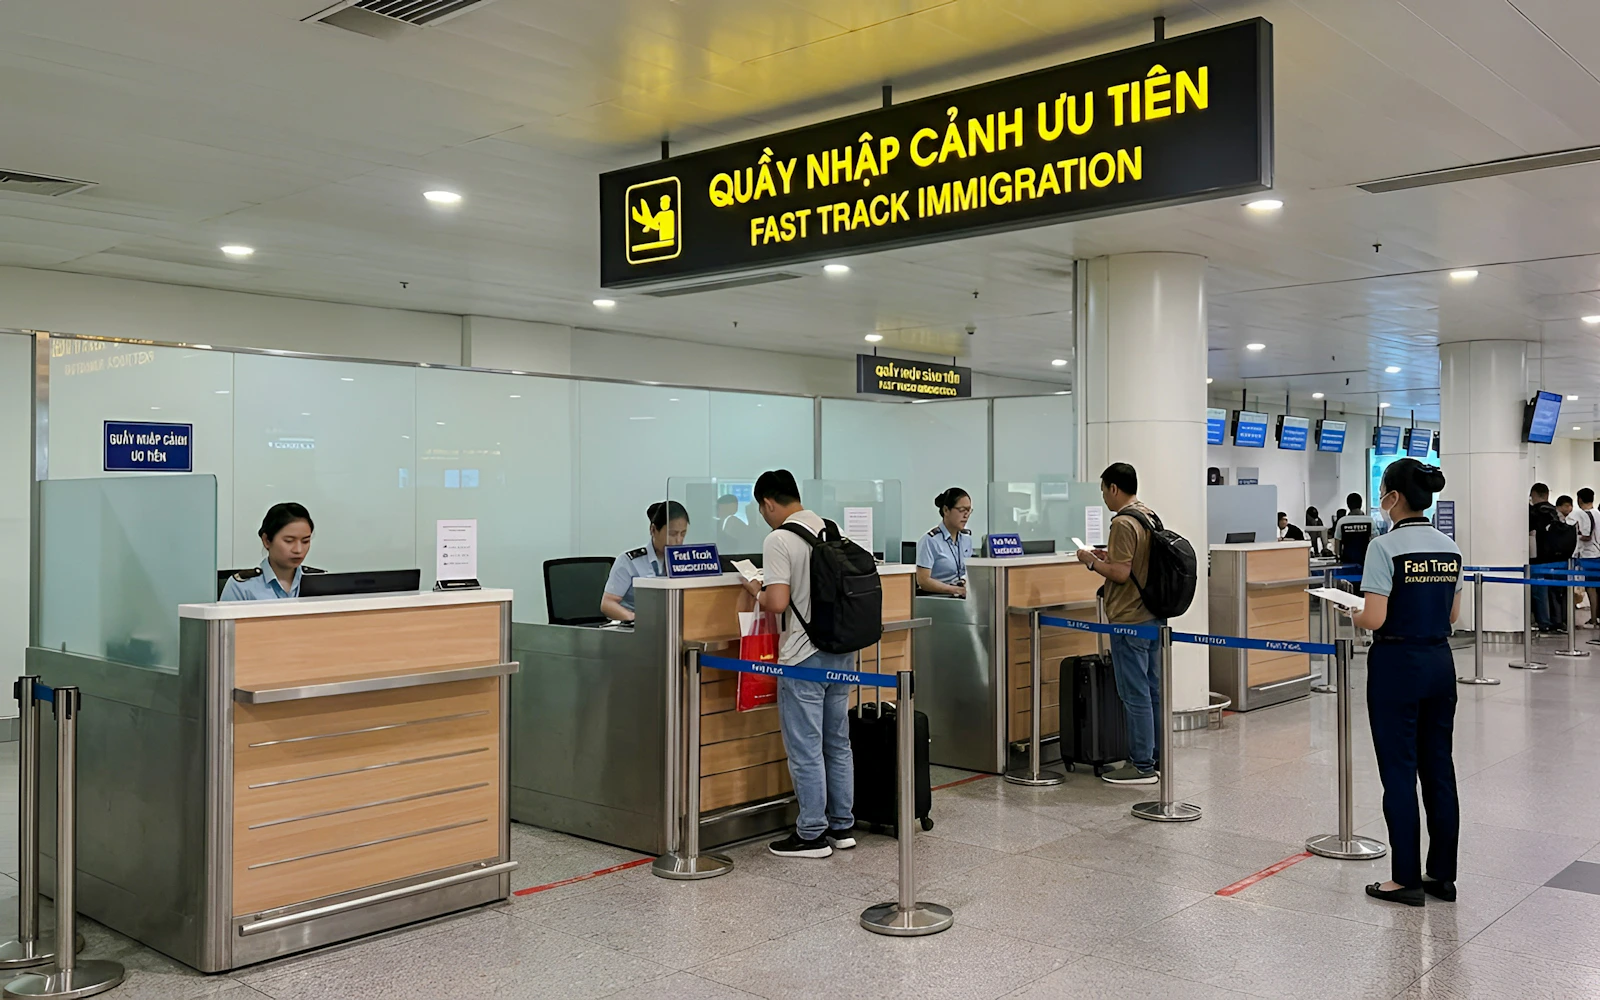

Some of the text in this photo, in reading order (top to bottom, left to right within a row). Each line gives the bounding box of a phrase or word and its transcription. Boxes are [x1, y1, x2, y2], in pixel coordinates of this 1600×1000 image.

[709, 64, 1209, 208] QUẦY NHẬP CẢNH ƯU TIÊN
[750, 145, 1142, 247] FAST TRACK IMMIGRATION
